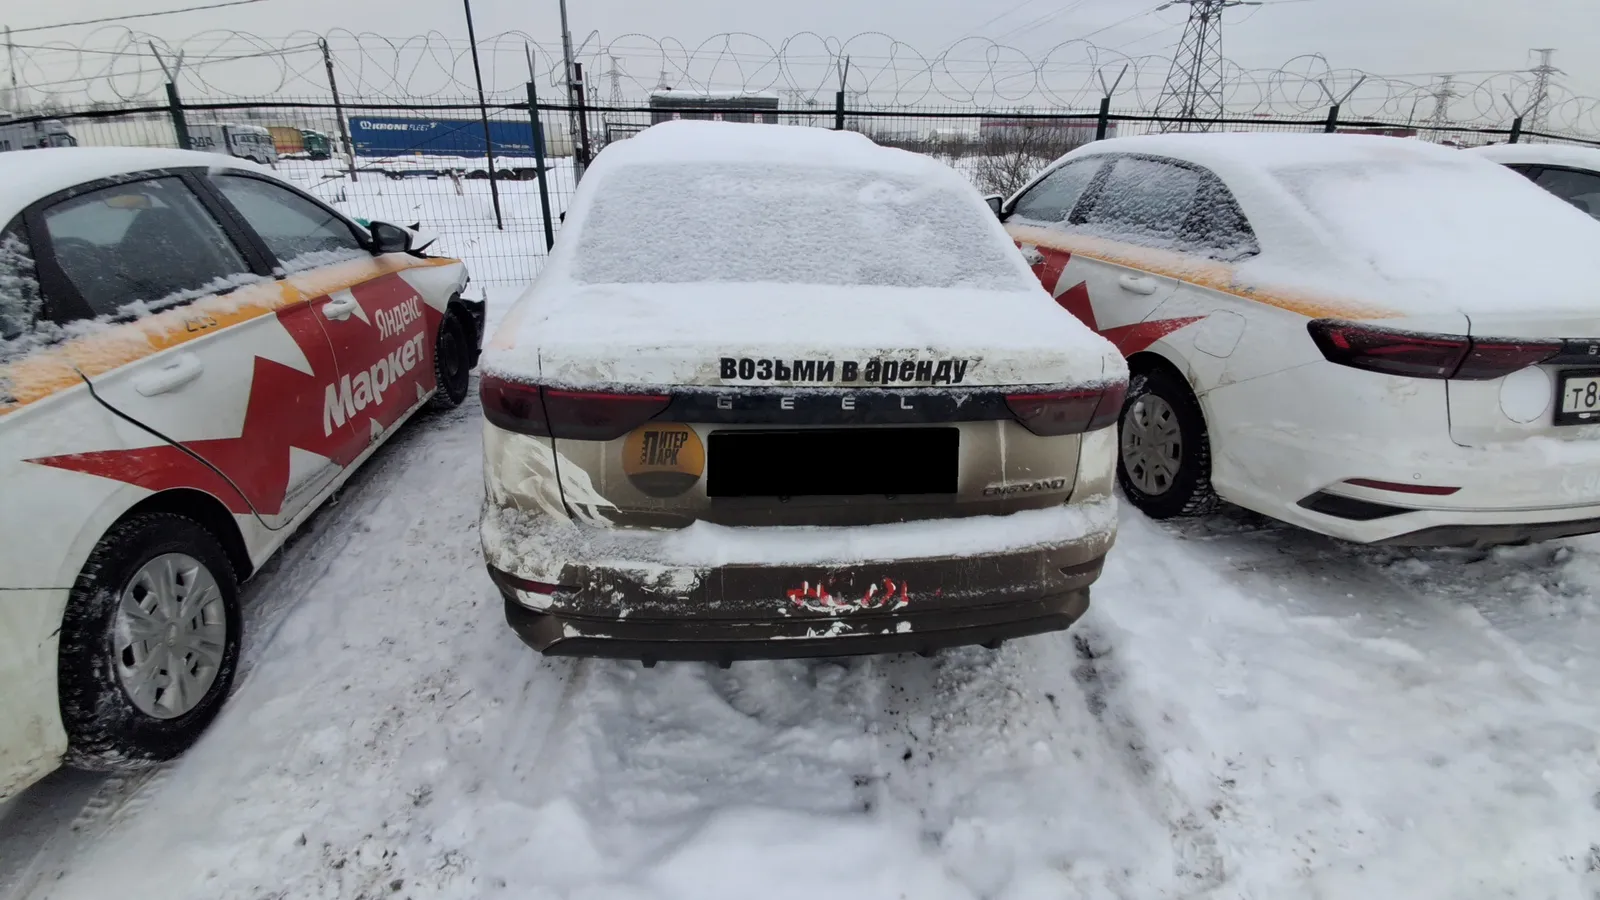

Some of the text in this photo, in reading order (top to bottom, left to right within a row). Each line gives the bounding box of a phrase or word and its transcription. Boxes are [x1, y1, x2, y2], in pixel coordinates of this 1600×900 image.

[372, 122, 430, 132] KRONE FLEET
[375, 295, 422, 341] Яндекс
[324, 331, 424, 437] Маркет
[720, 357, 969, 385] возьми в аренду
[717, 395, 970, 410] GEELY
[1572, 381, 1600, 409] Т8
